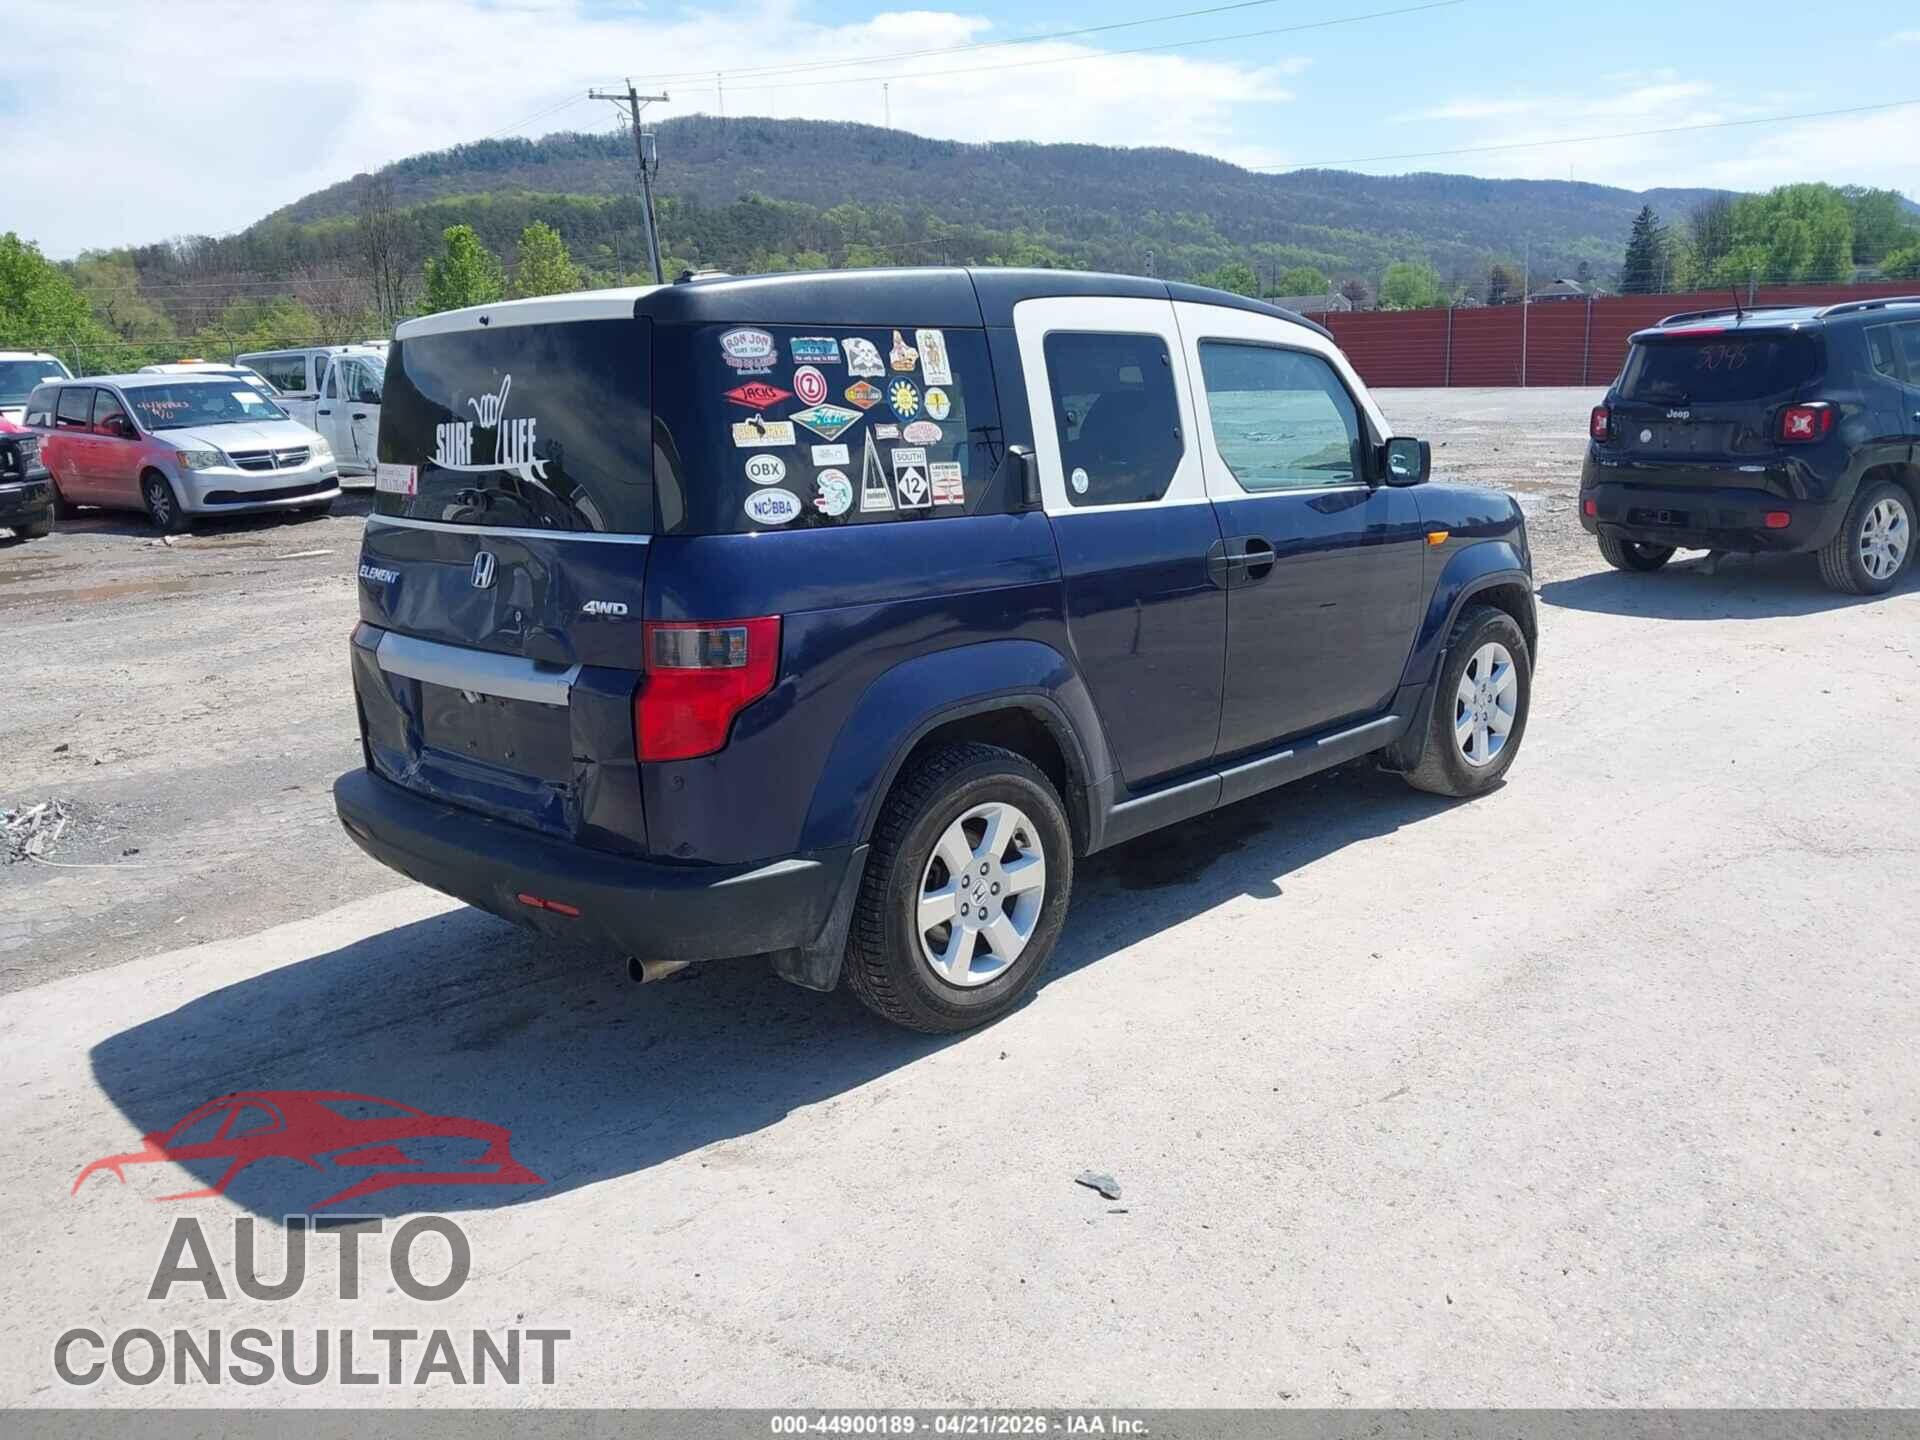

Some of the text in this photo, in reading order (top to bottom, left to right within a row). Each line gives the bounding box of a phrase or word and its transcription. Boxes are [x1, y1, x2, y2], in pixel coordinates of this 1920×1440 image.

[726, 334, 769, 350] RON JON
[742, 388, 777, 401] JACKS
[1666, 408, 1690, 420] Jeep
[436, 418, 537, 465] SURF LIFE
[896, 453, 922, 461] SOUTH
[750, 463, 780, 476] OBX
[905, 477, 921, 495] 12
[359, 564, 399, 583] ELEMENT
[582, 600, 629, 616] 4WD
